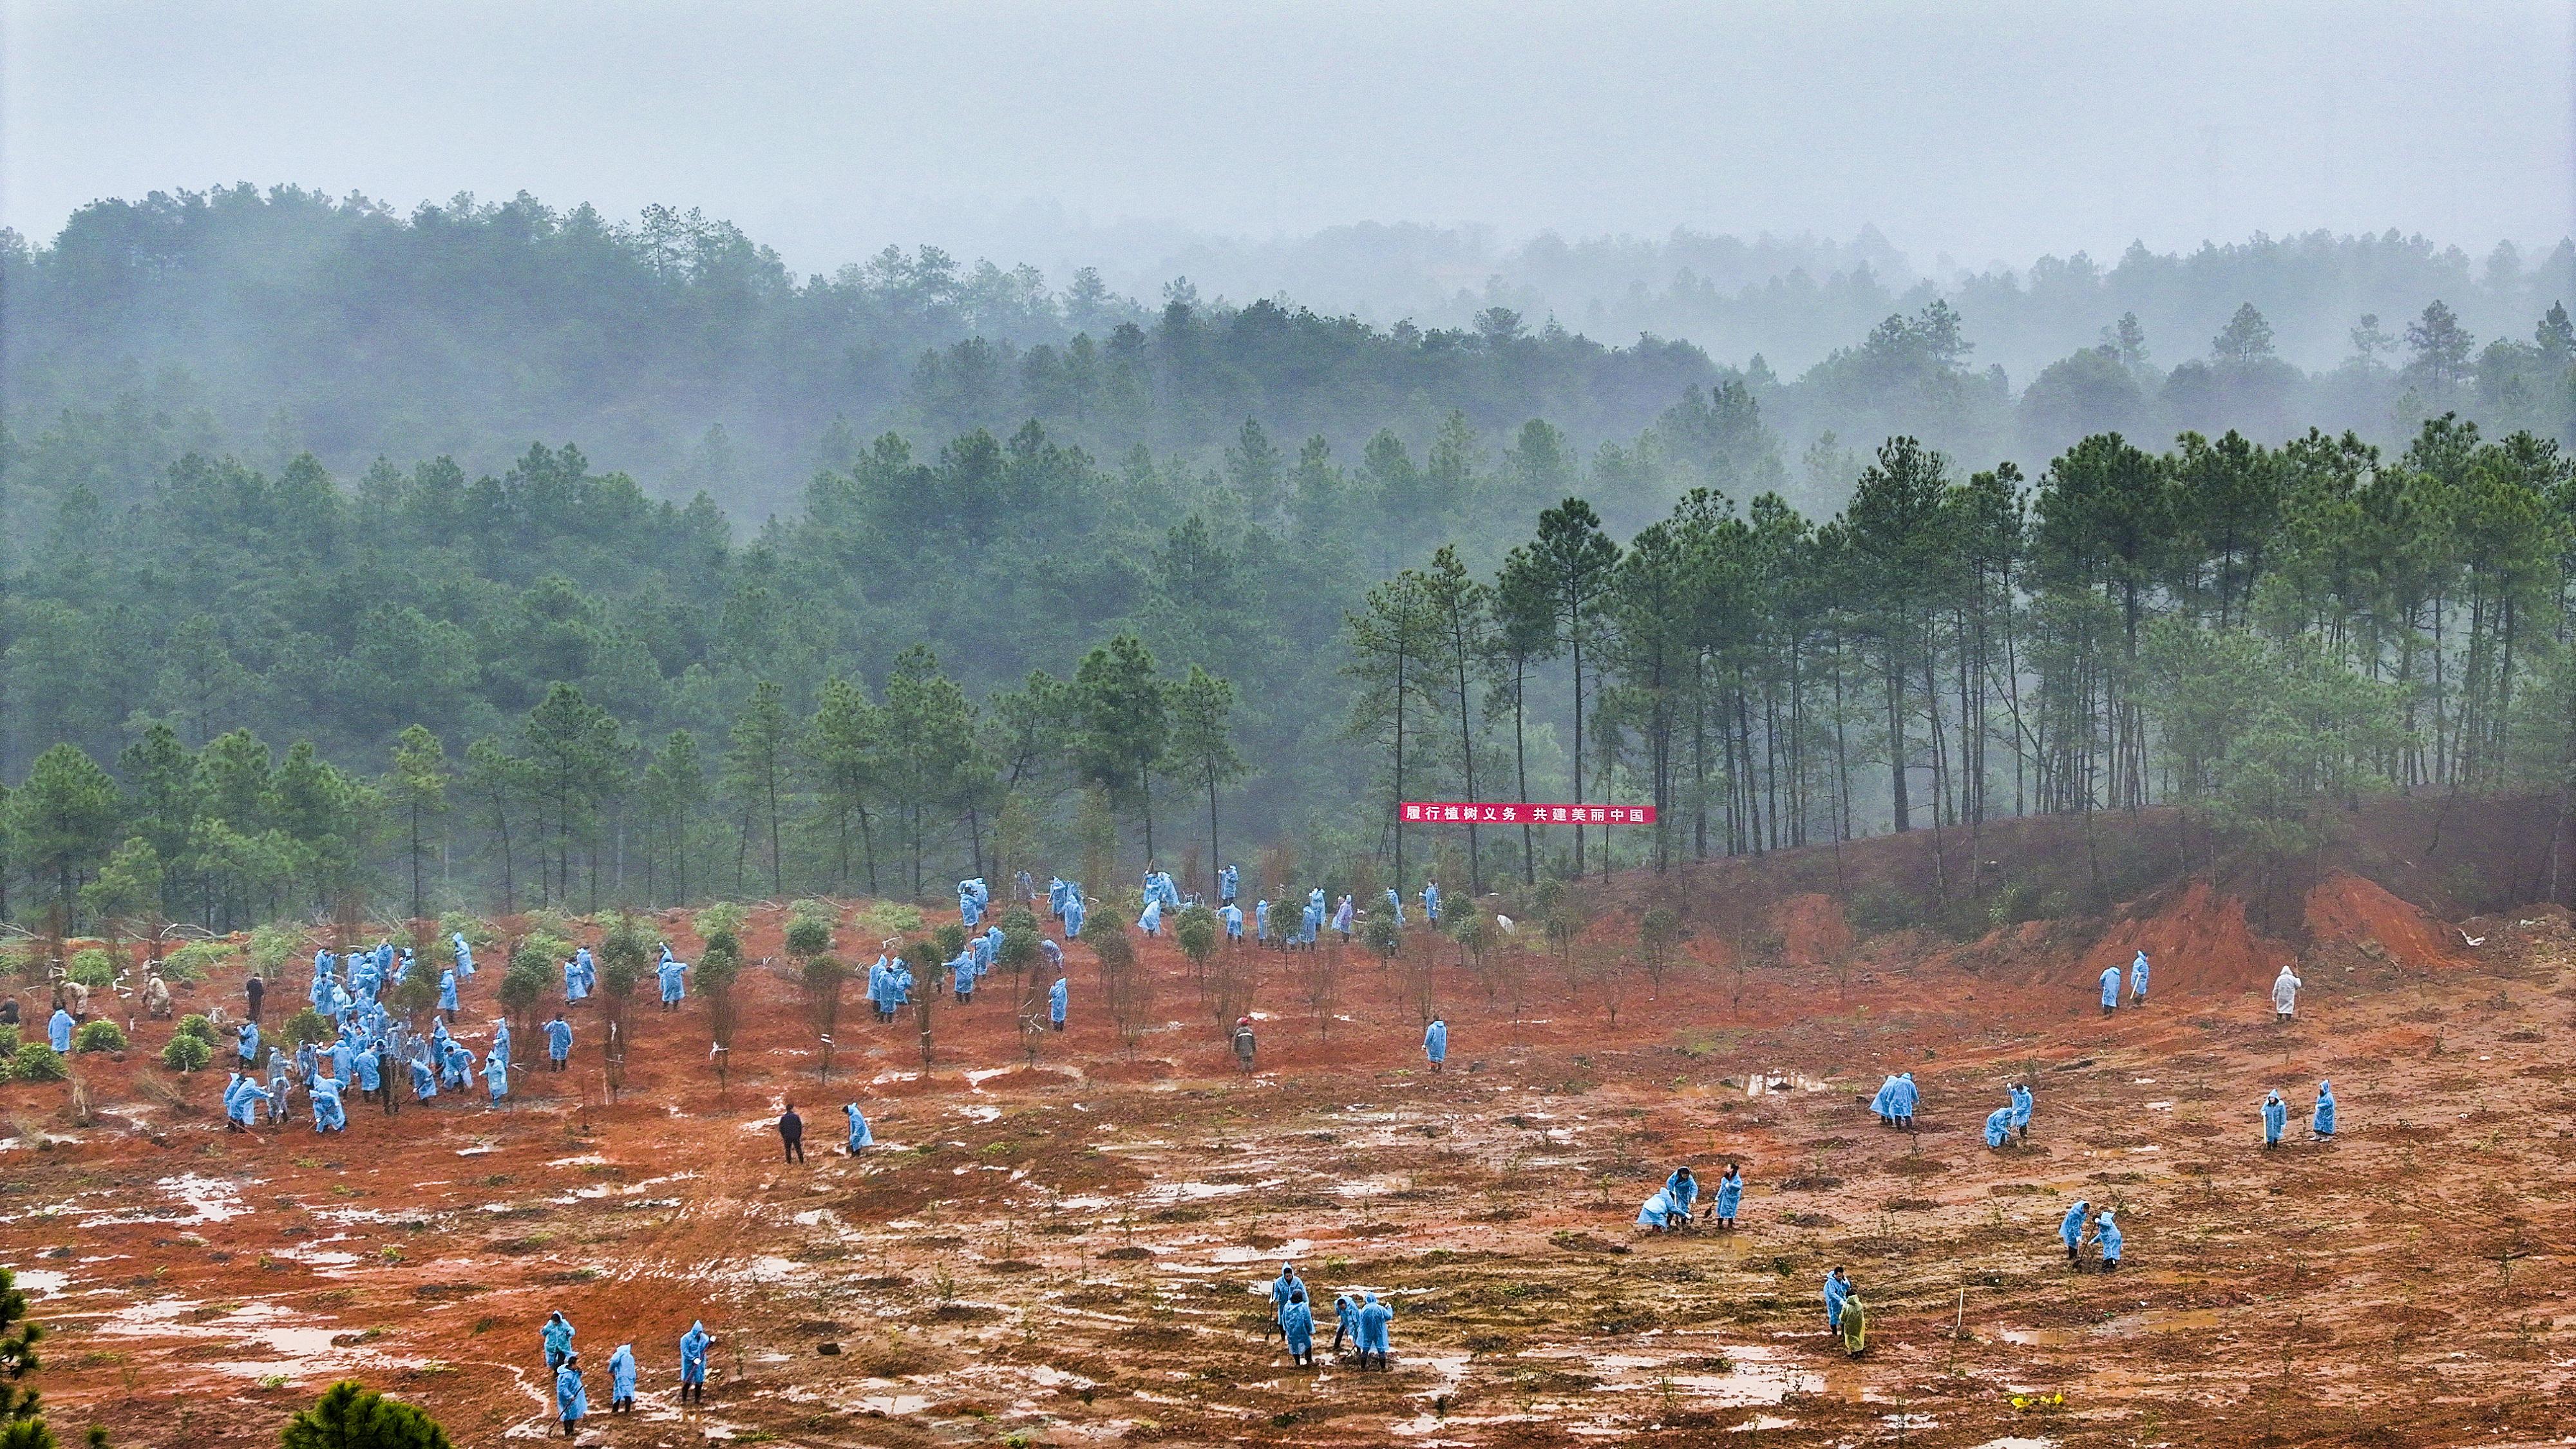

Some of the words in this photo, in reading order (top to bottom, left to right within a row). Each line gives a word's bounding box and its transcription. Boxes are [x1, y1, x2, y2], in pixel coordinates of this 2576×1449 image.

[1406, 806, 1517, 820] 履行植树义务
[1533, 808, 1644, 822] 共建美丽中国
